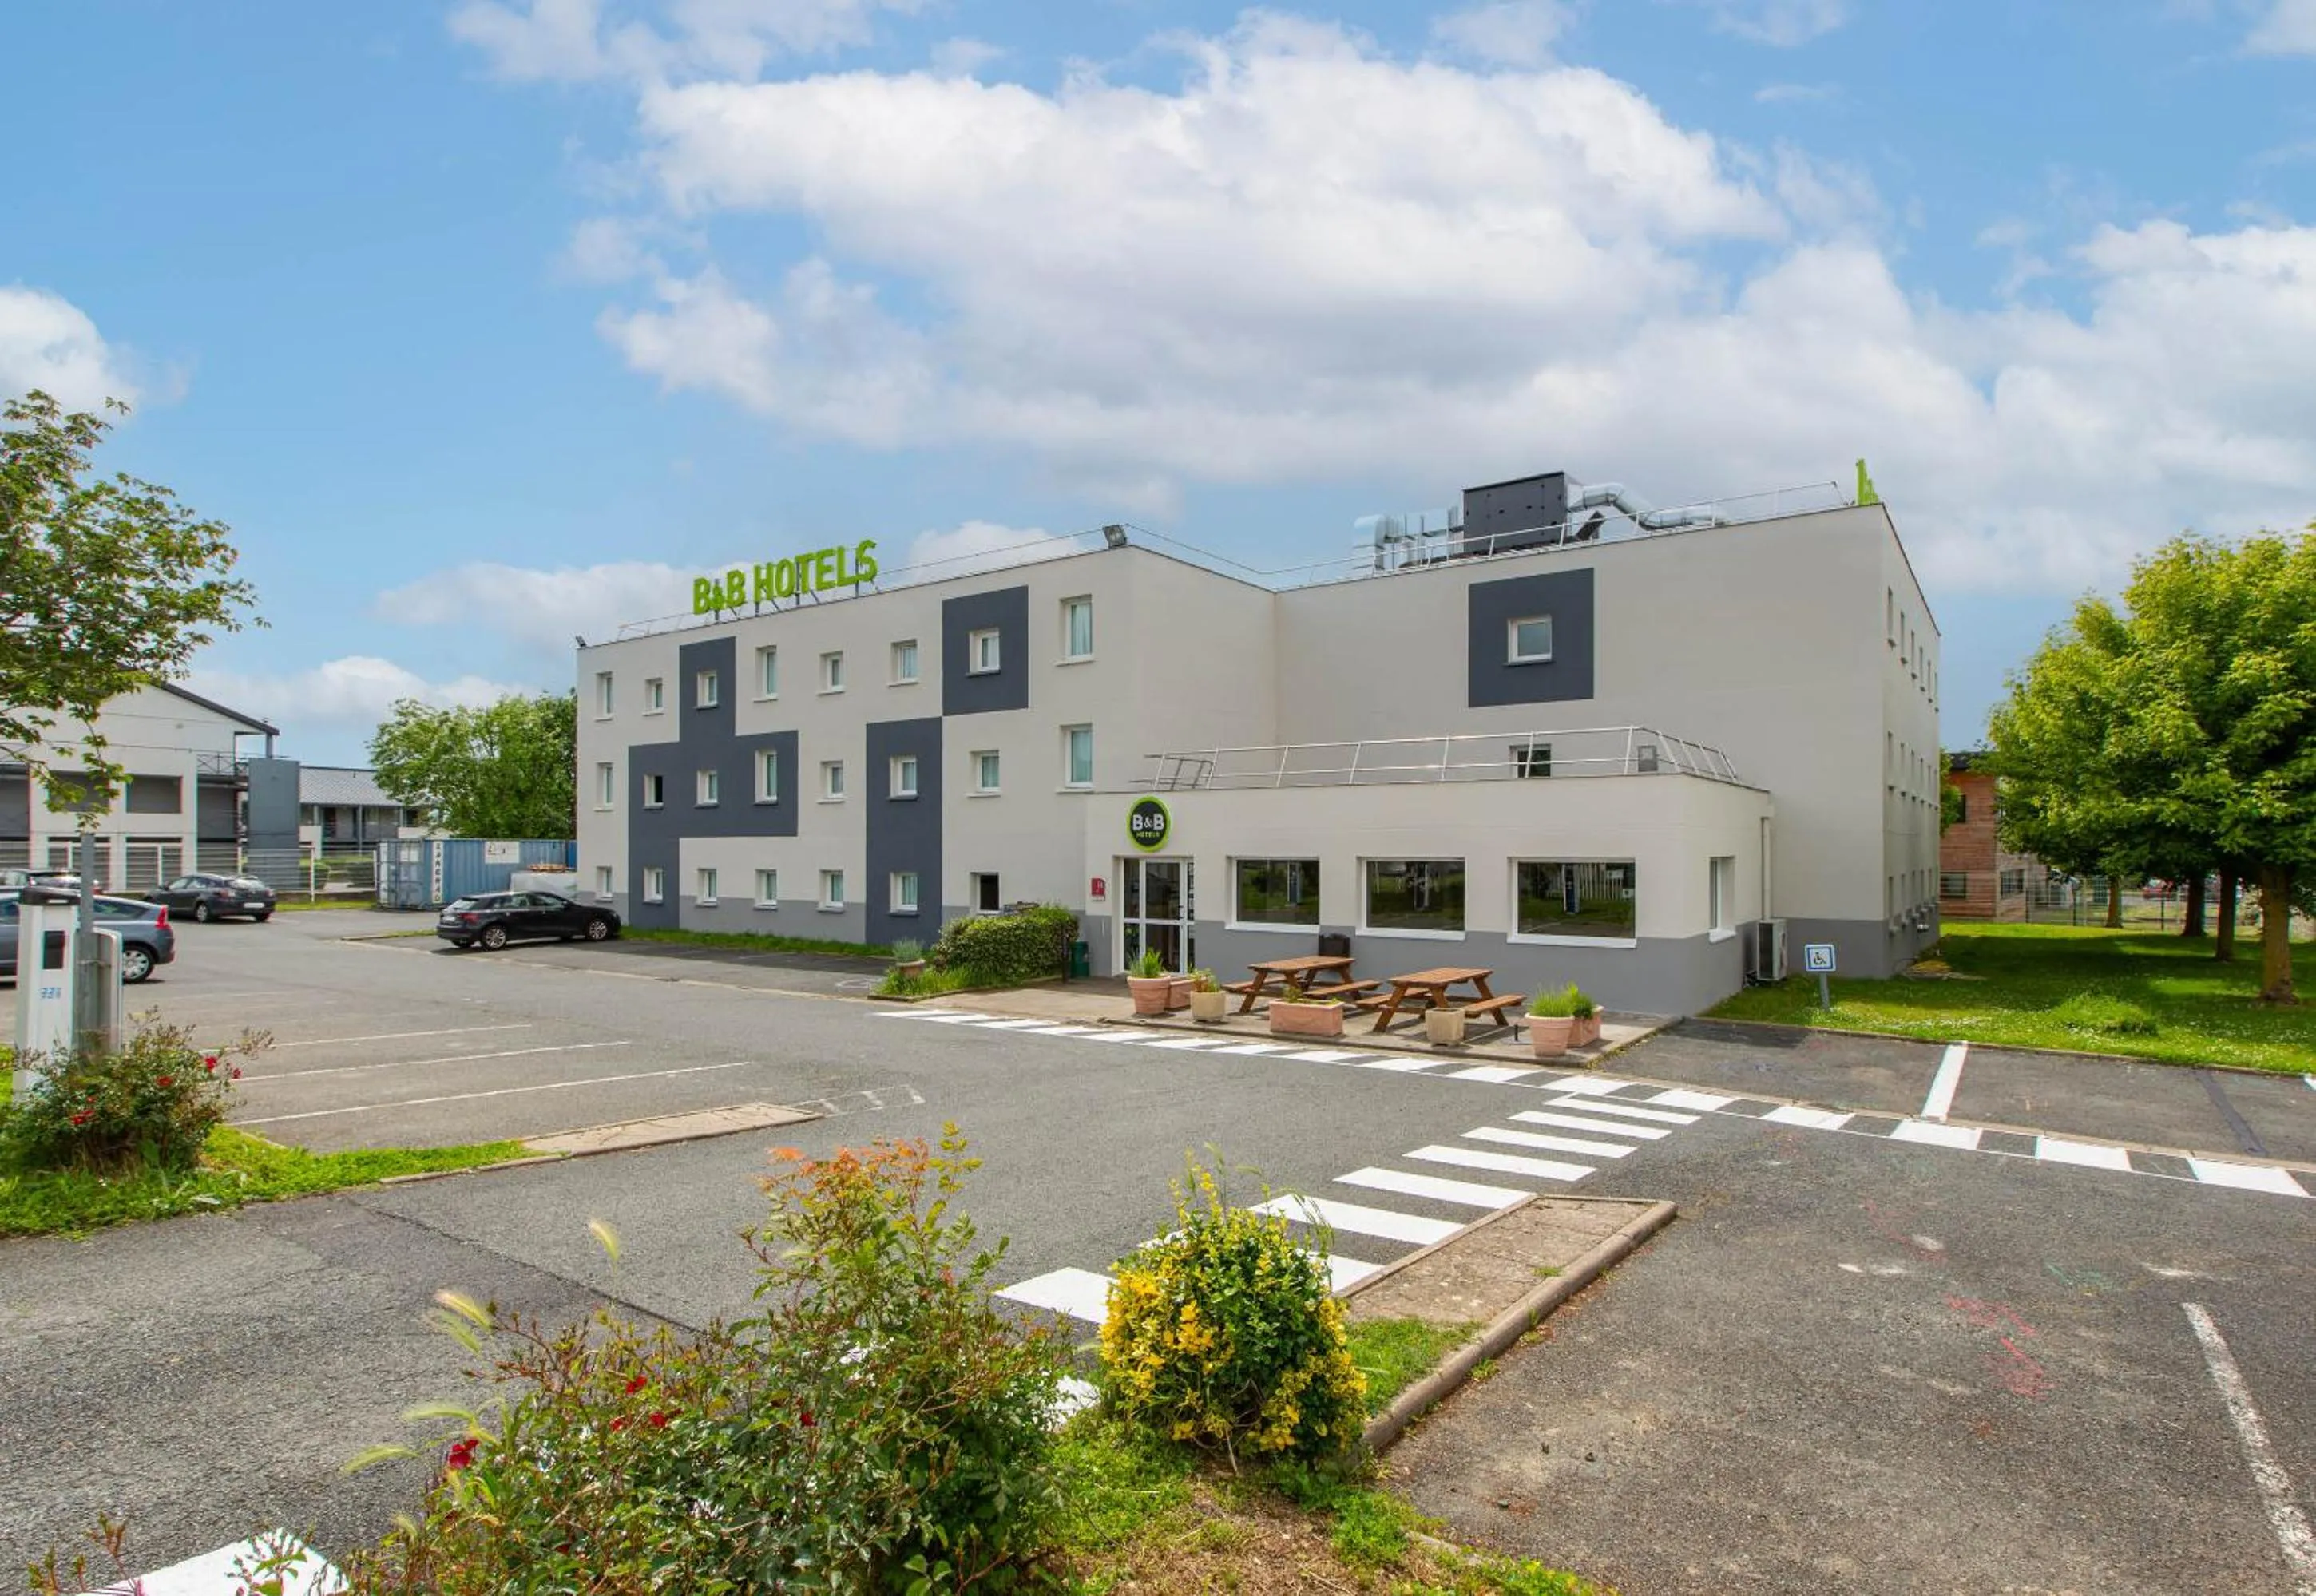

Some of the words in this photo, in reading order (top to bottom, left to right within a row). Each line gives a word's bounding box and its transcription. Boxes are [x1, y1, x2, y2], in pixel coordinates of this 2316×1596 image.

[693, 569, 746, 615] B&B
[753, 538, 878, 603] HOTELS
[1132, 814, 1164, 830] B&B
